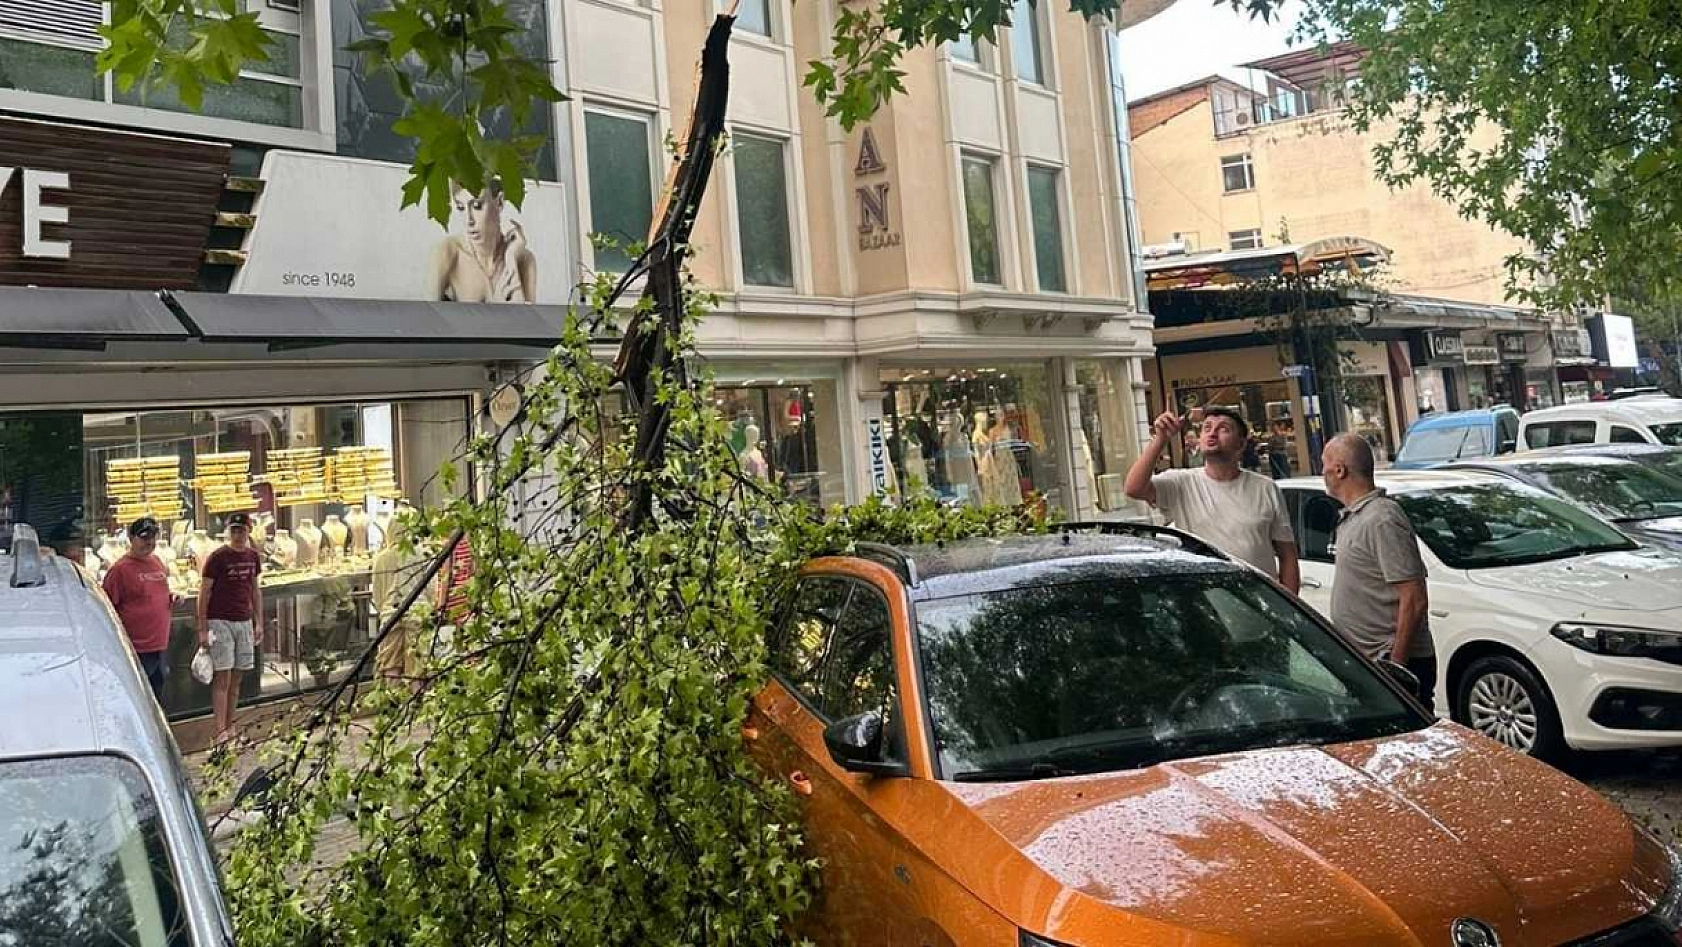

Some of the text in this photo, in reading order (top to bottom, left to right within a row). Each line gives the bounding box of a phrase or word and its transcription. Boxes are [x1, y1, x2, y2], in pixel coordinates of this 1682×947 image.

[0, 166, 71, 259] E
[282, 269, 356, 288] since 1948
